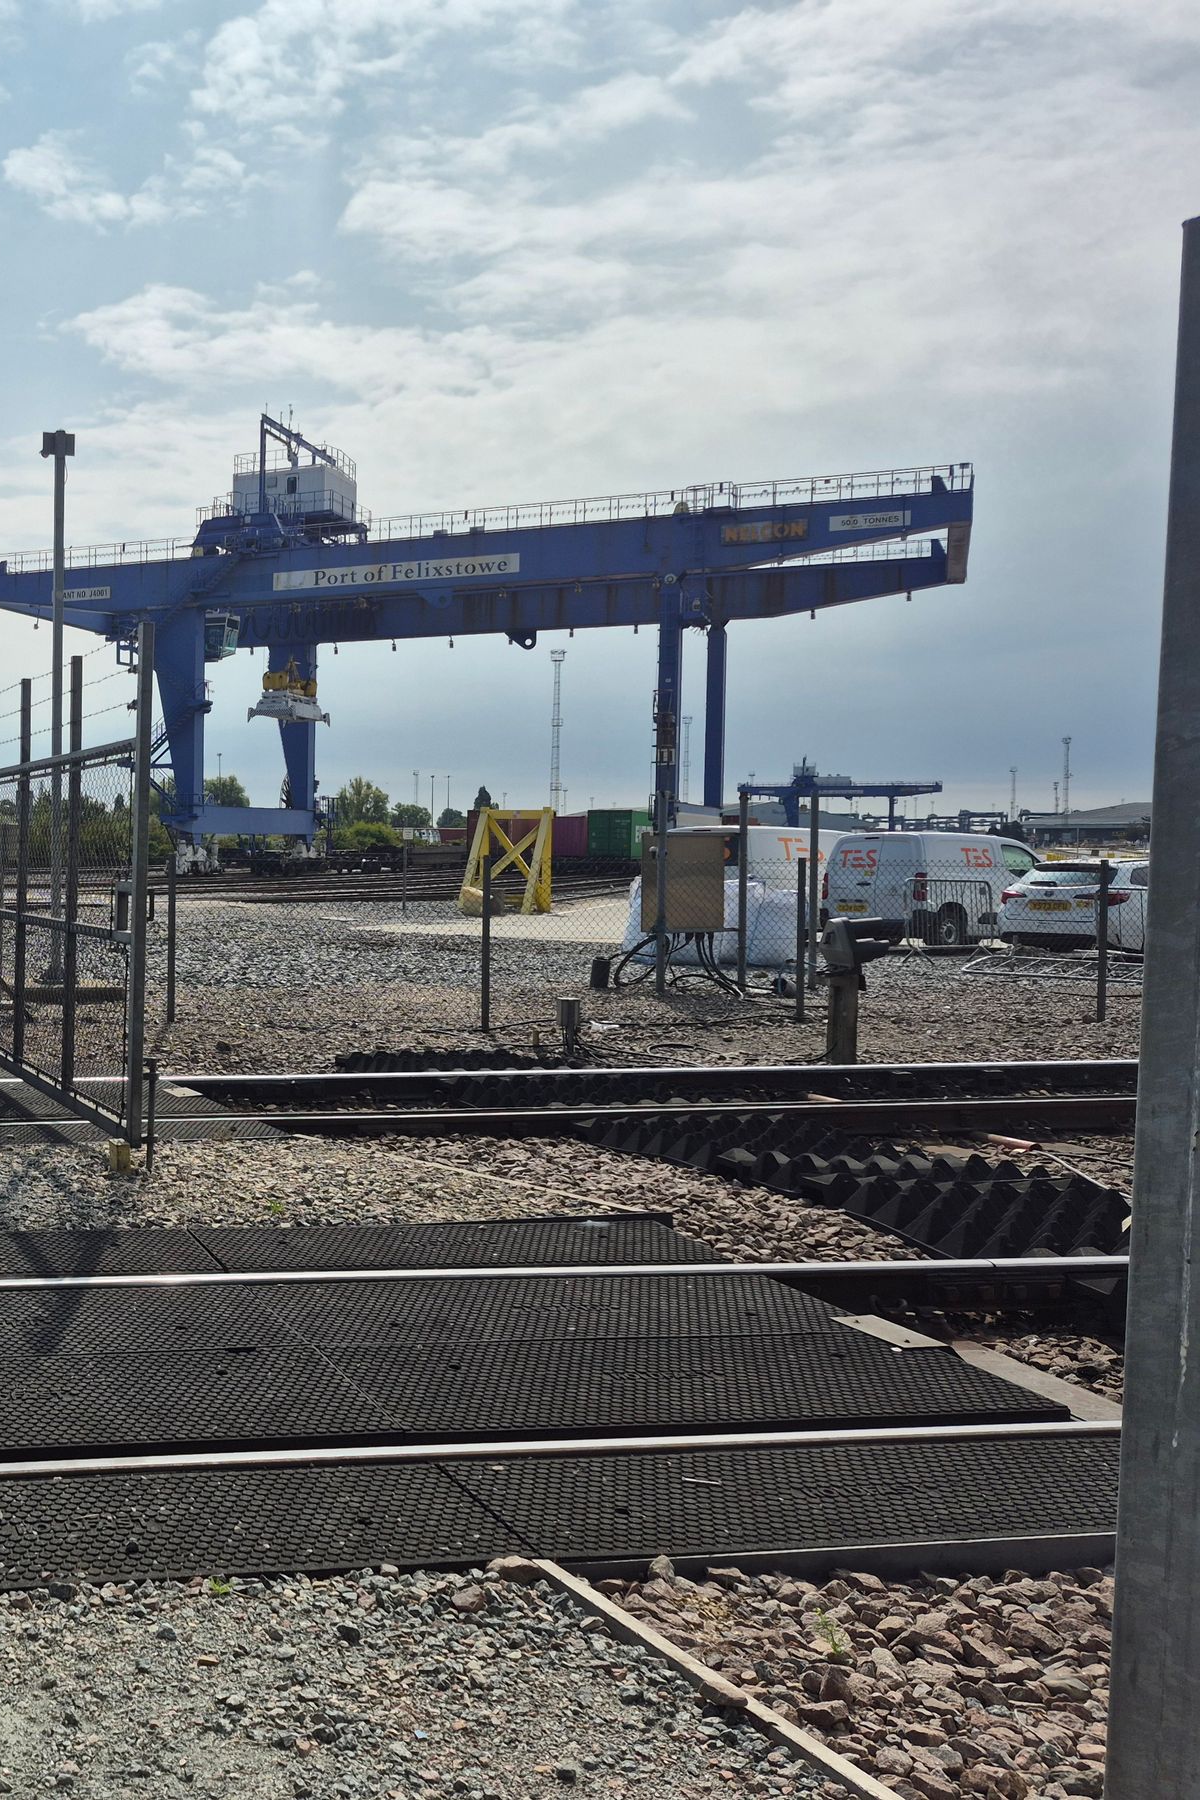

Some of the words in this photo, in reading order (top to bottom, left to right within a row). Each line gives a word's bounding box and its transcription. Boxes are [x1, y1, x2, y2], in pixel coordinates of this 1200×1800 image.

[863, 515, 900, 525] TONNES
[313, 570, 357, 586] Port
[364, 564, 387, 582] of
[391, 560, 508, 580] Felixstowe
[840, 849, 877, 868] TES
[960, 847, 992, 867] TES
